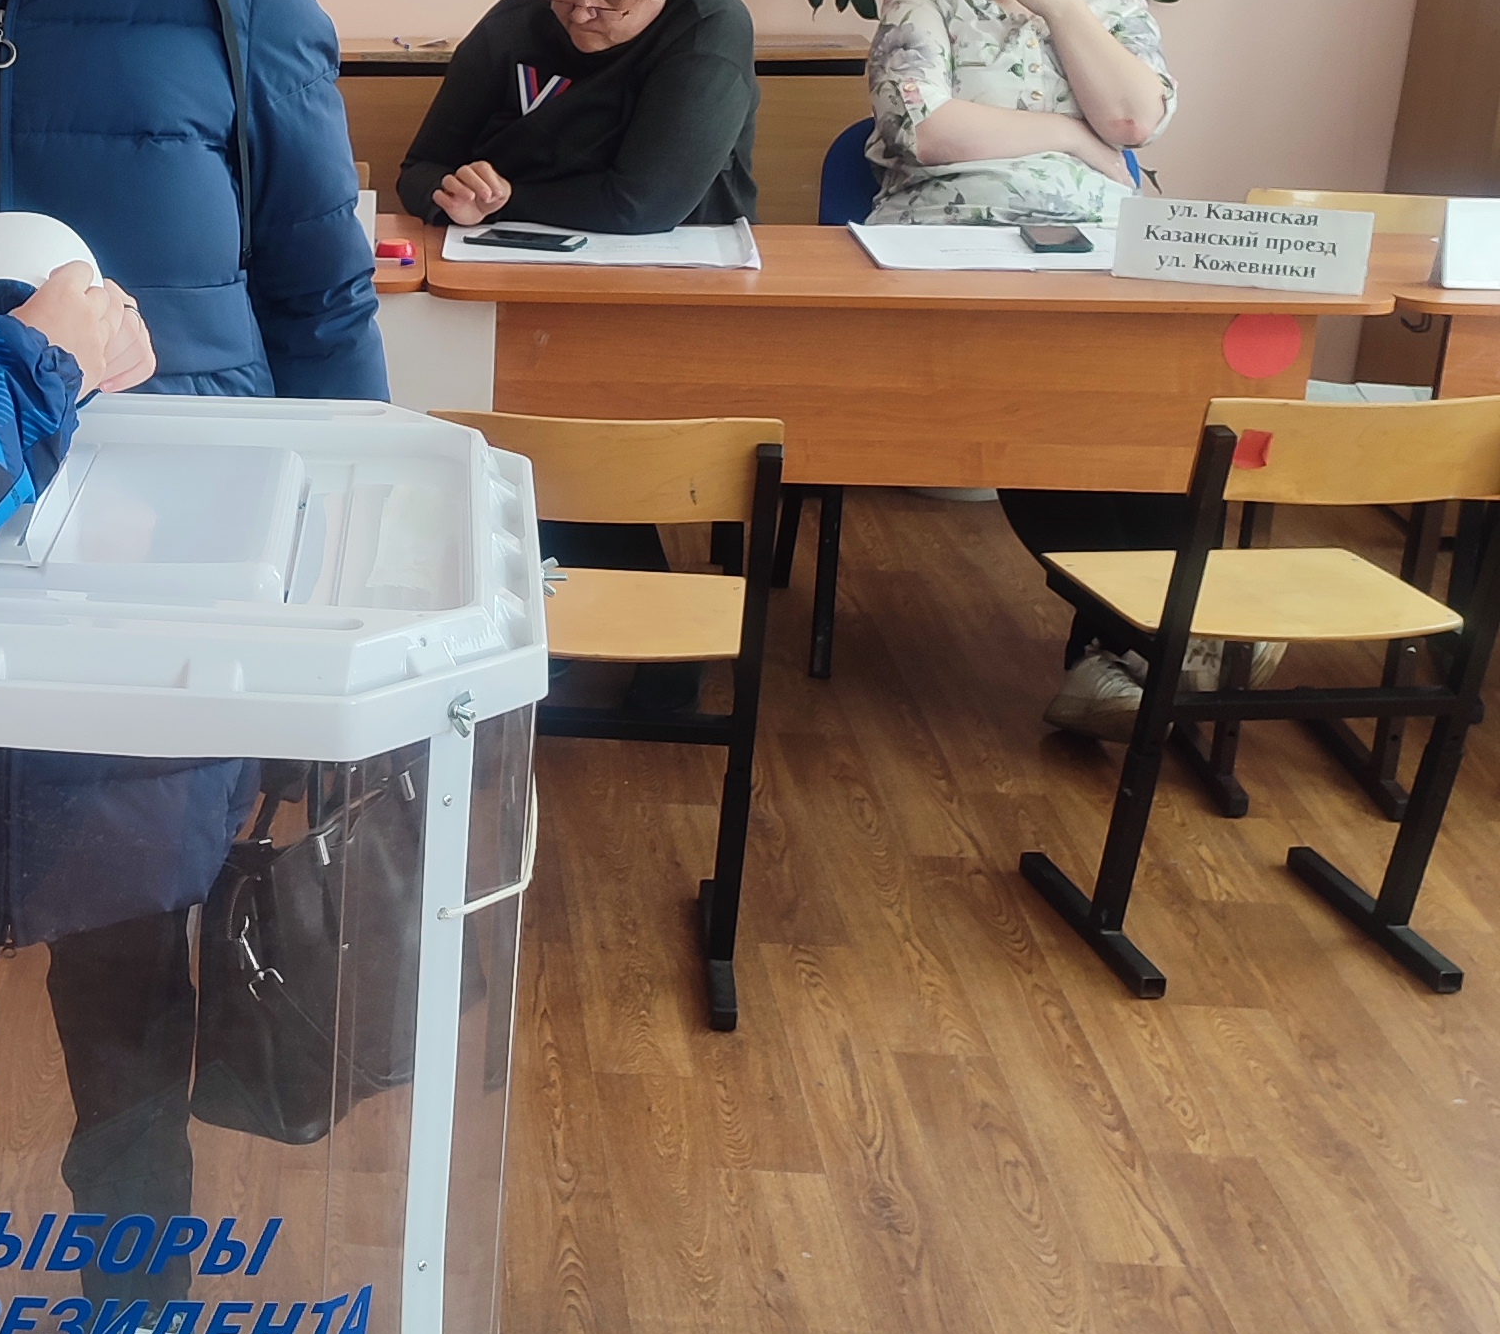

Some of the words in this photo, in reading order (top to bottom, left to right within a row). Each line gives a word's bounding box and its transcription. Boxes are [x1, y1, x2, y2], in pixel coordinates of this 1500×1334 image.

[1167, 203, 1198, 221] ул.
[1206, 203, 1319, 227] Казанская
[1144, 224, 1258, 248] Казанский
[1265, 237, 1338, 257] проезд
[1155, 253, 1186, 271] ул.
[1192, 253, 1317, 279] Кожевники
